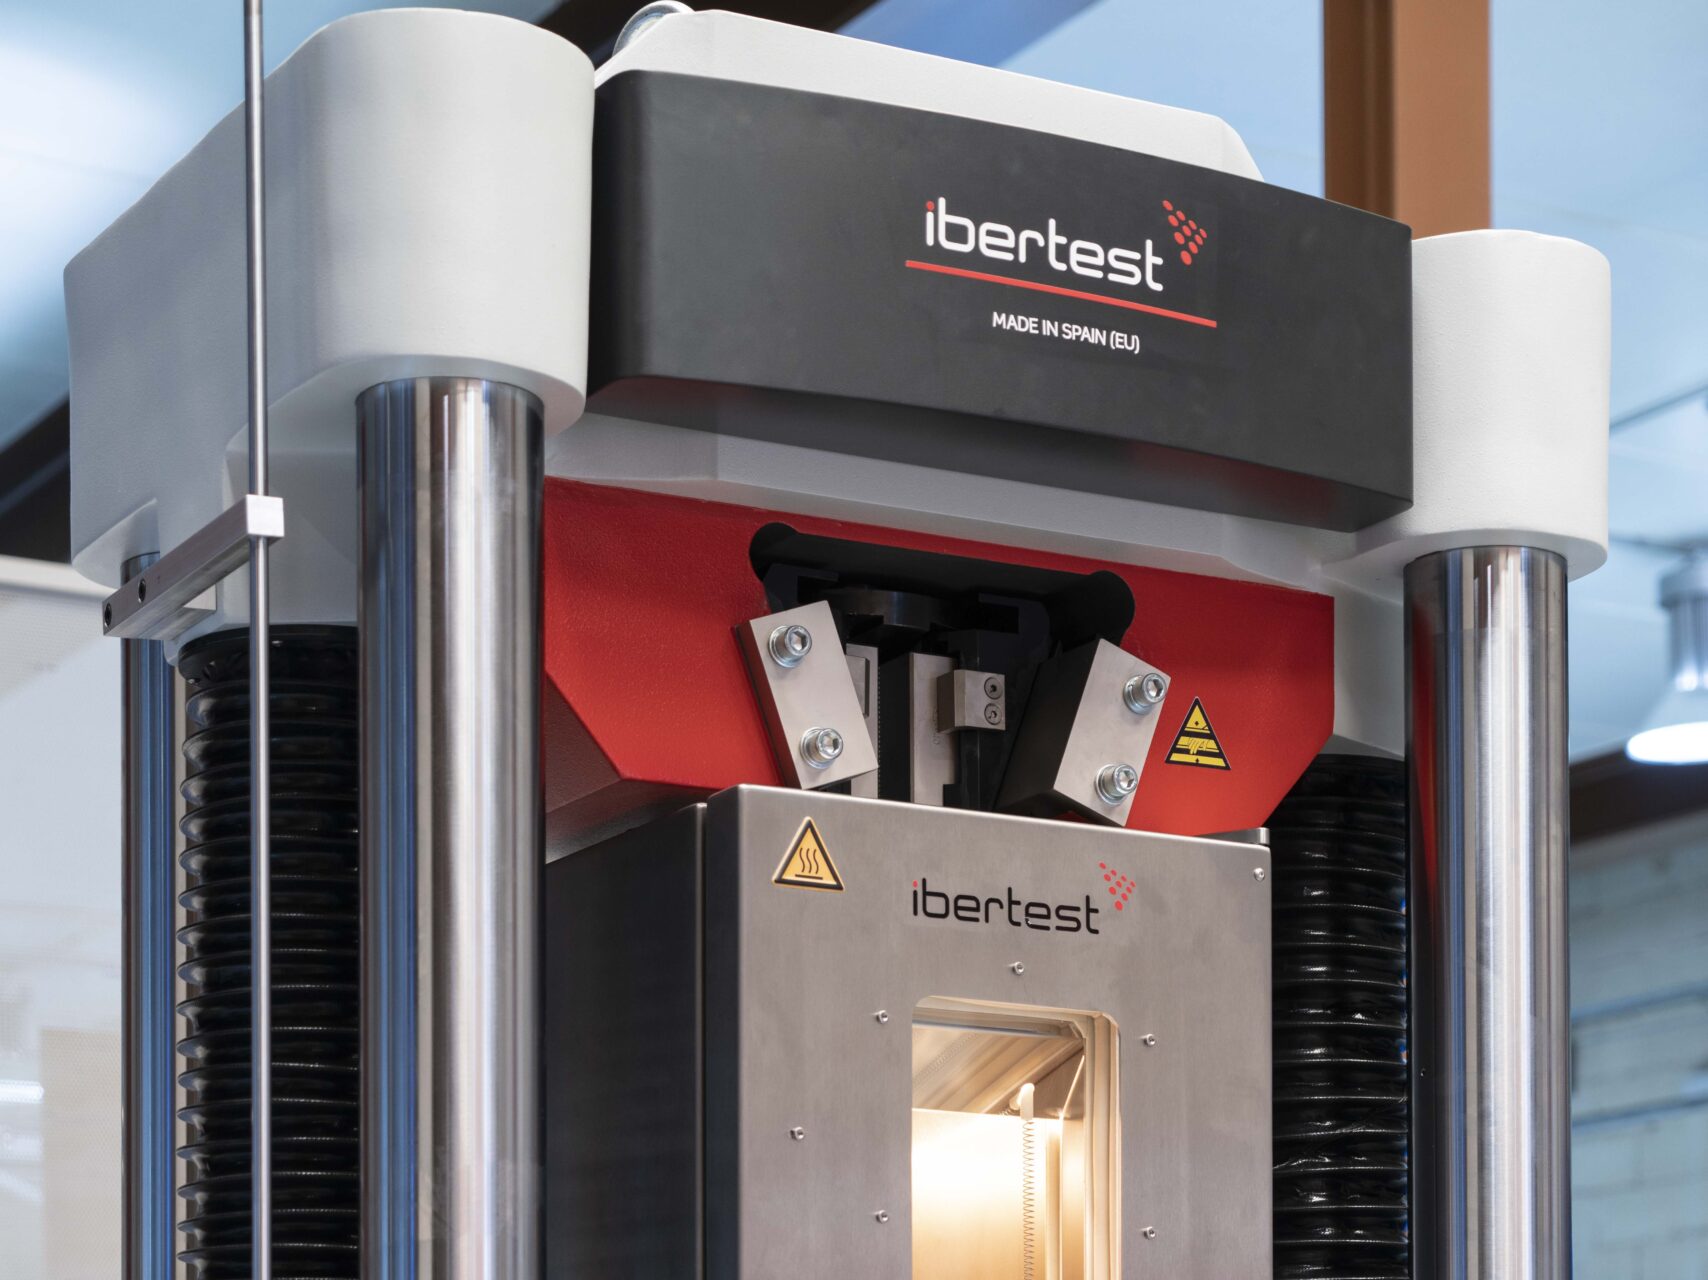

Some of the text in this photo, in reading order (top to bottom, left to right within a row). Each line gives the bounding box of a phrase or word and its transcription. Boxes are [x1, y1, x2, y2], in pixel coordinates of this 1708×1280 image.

[925, 196, 1164, 292] ibertest
[992, 311, 1140, 354] MADE IN SPAIN (EU)
[912, 877, 1100, 935] ibertest
